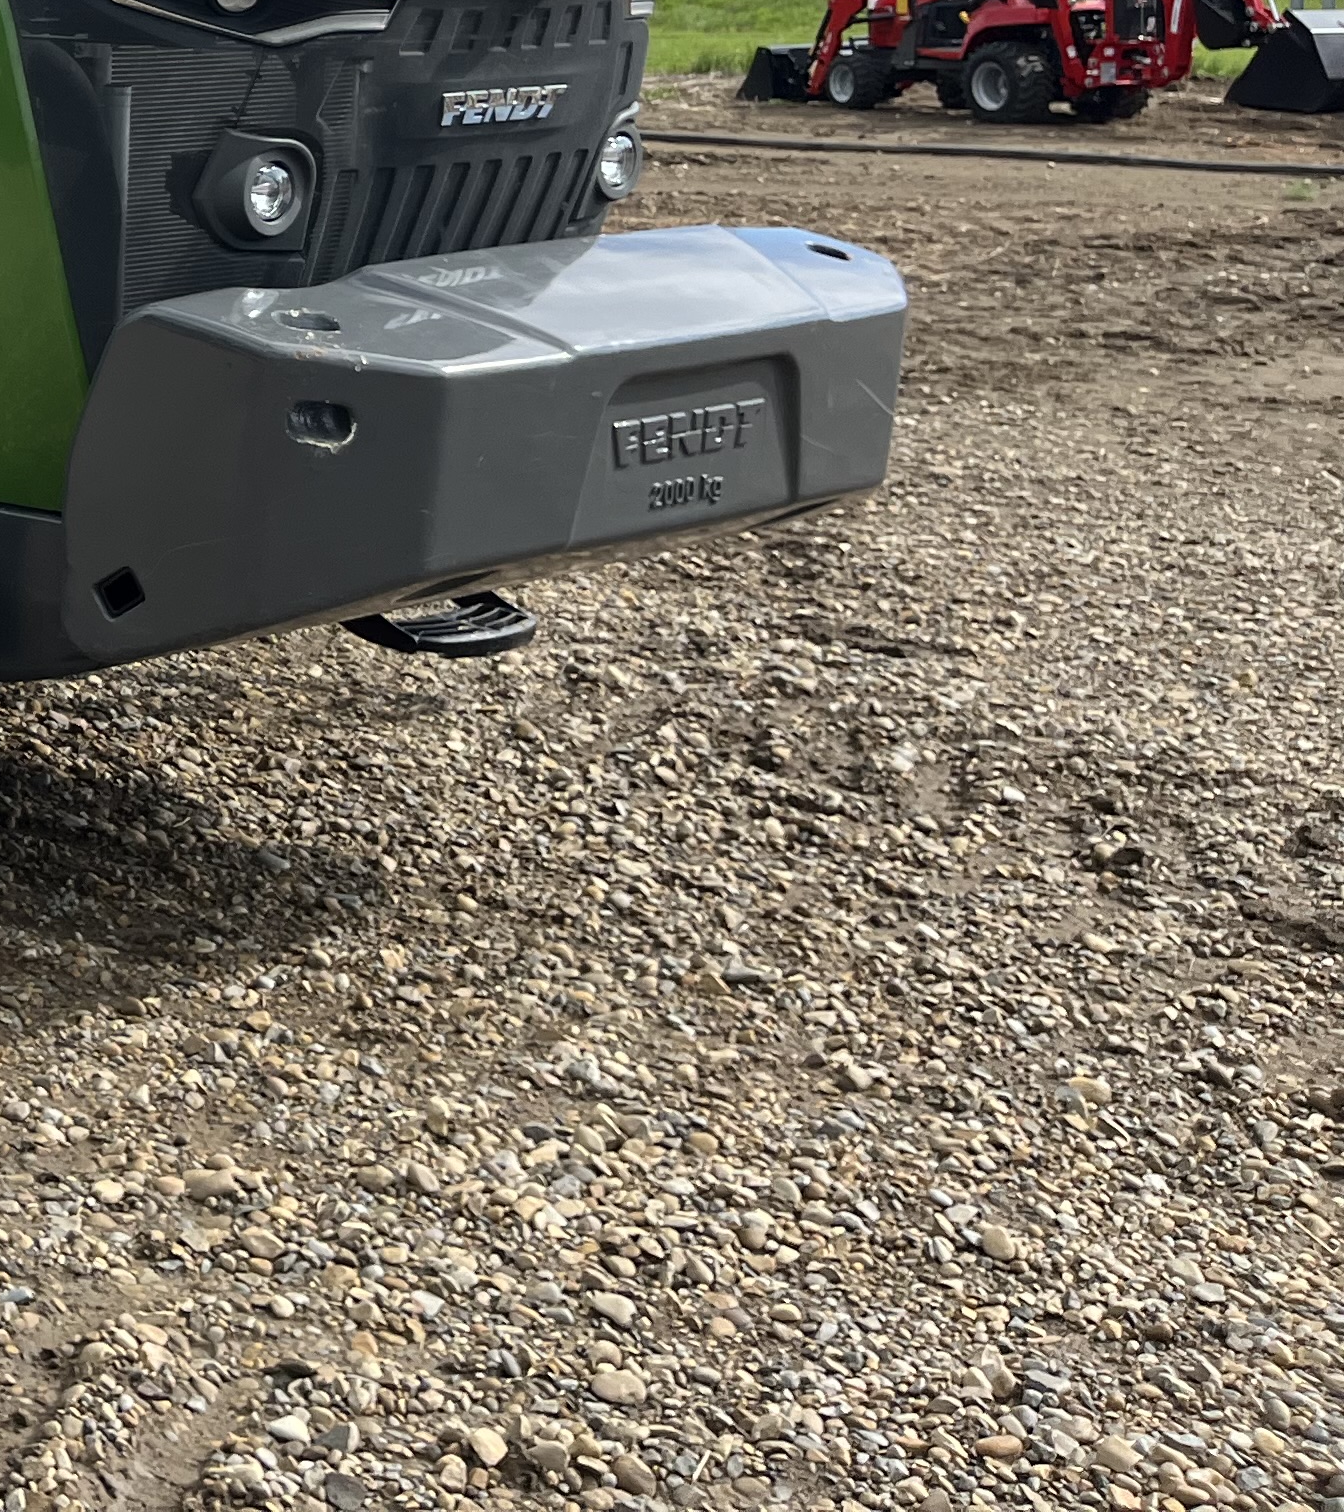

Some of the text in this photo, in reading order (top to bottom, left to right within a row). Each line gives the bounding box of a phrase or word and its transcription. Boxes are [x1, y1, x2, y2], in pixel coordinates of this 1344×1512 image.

[440, 84, 568, 126] FENDT
[612, 397, 766, 471] FENDT
[648, 473, 725, 512] 2000 kg
